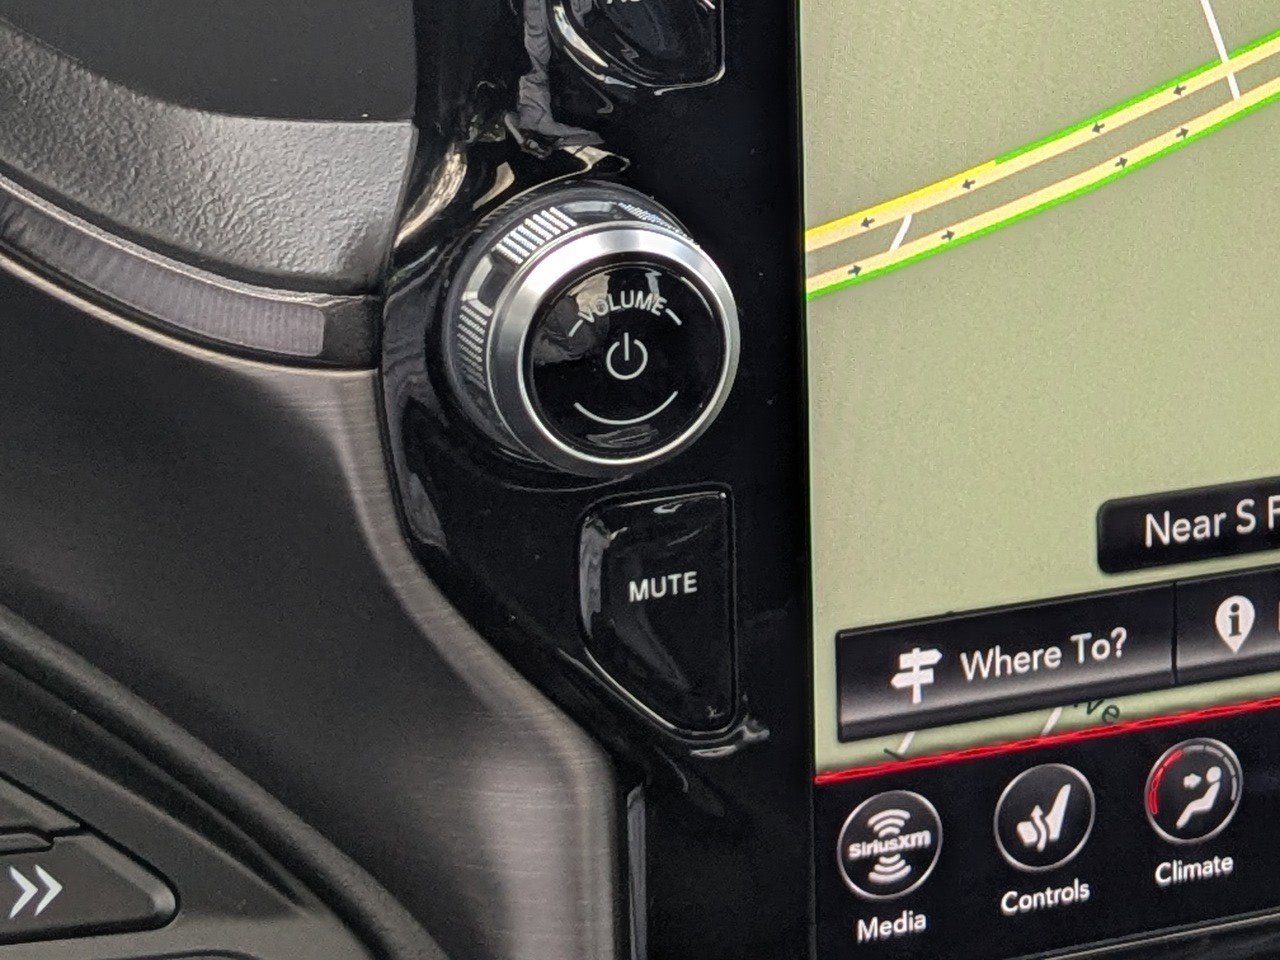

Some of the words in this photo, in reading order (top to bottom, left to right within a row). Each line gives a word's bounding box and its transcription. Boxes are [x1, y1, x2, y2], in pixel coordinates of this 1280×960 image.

[580, 290, 668, 324] VOLUME
[1144, 510, 1228, 548] Near
[1235, 499, 1256, 534] S
[629, 570, 698, 602] MUTE
[959, 644, 1062, 682] Where
[1070, 627, 1128, 662] To?
[1154, 853, 1234, 887] Climate
[1001, 878, 1091, 916] Controls
[857, 911, 927, 943] Media
